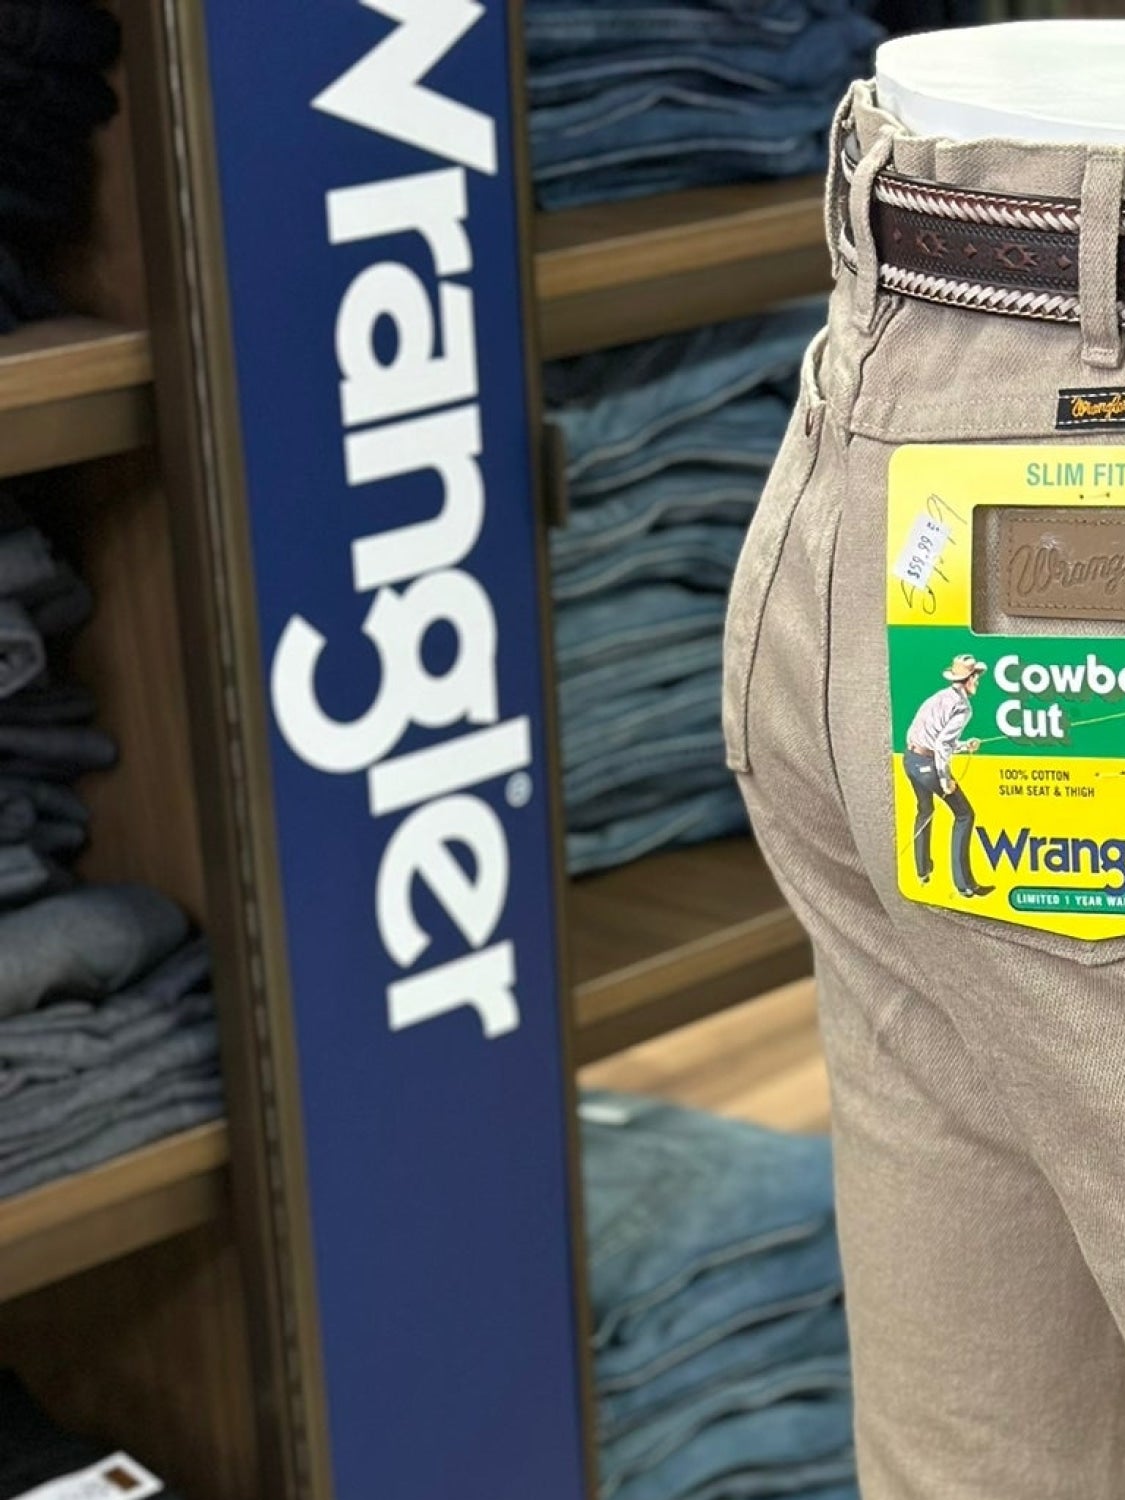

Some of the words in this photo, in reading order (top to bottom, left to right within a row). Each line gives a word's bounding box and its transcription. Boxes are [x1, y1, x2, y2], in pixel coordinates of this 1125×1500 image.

[1026, 462, 1084, 487] SLIM
[906, 535, 934, 579] $59.99
[995, 699, 1065, 739] Cut
[998, 768, 1029, 781] 100%
[1031, 769, 1070, 782] COTTON
[998, 785, 1023, 797] SLIM
[1026, 785, 1051, 797] SEAT
[1053, 786, 1062, 797] &
[1064, 786, 1095, 798] THIGH
[1015, 893, 1060, 906] LIMITED
[1064, 895, 1070, 906] 1
[1074, 894, 1103, 907] YEAR
